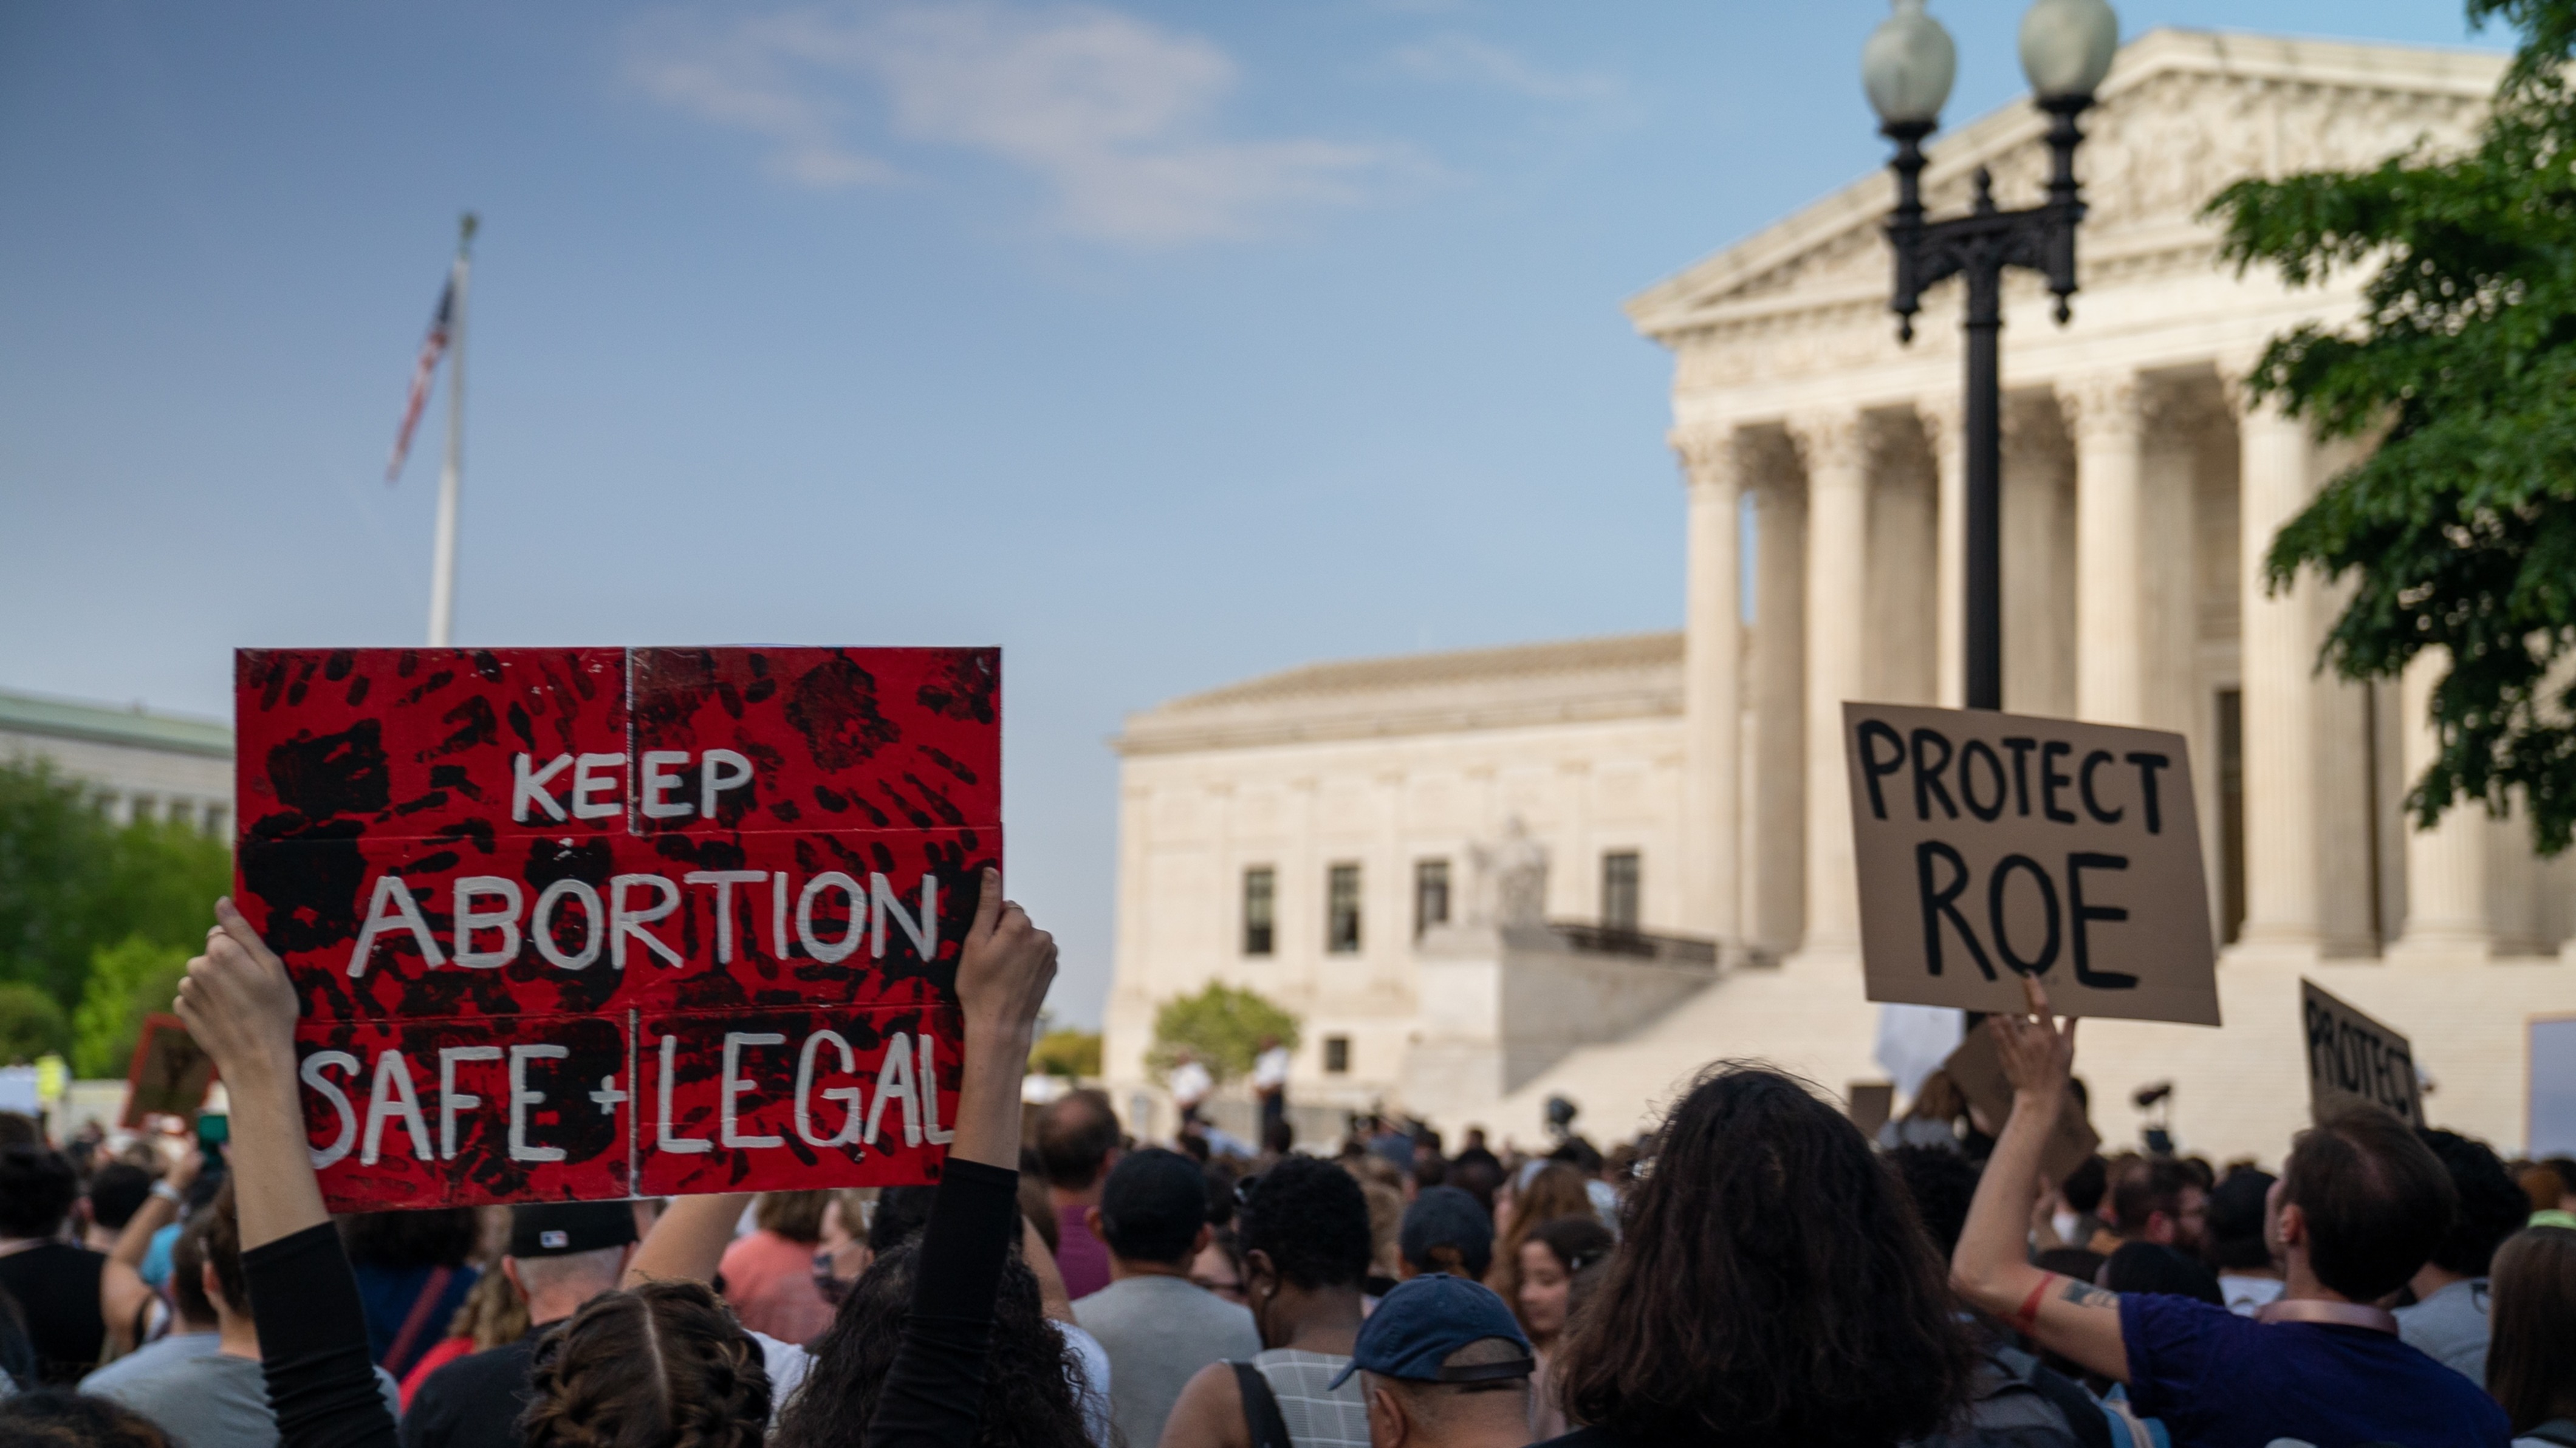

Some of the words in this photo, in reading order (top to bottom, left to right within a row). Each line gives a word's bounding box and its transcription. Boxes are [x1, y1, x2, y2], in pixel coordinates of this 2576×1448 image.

[513, 749, 753, 822] KEEP
[1857, 719, 2170, 835] PROTECT
[347, 870, 937, 977] ABORTION
[1916, 841, 2139, 989] ROE
[300, 1045, 569, 1169] SAFE
[658, 1031, 955, 1154] LEGAL
[2307, 999, 2414, 1116] PROTECT
